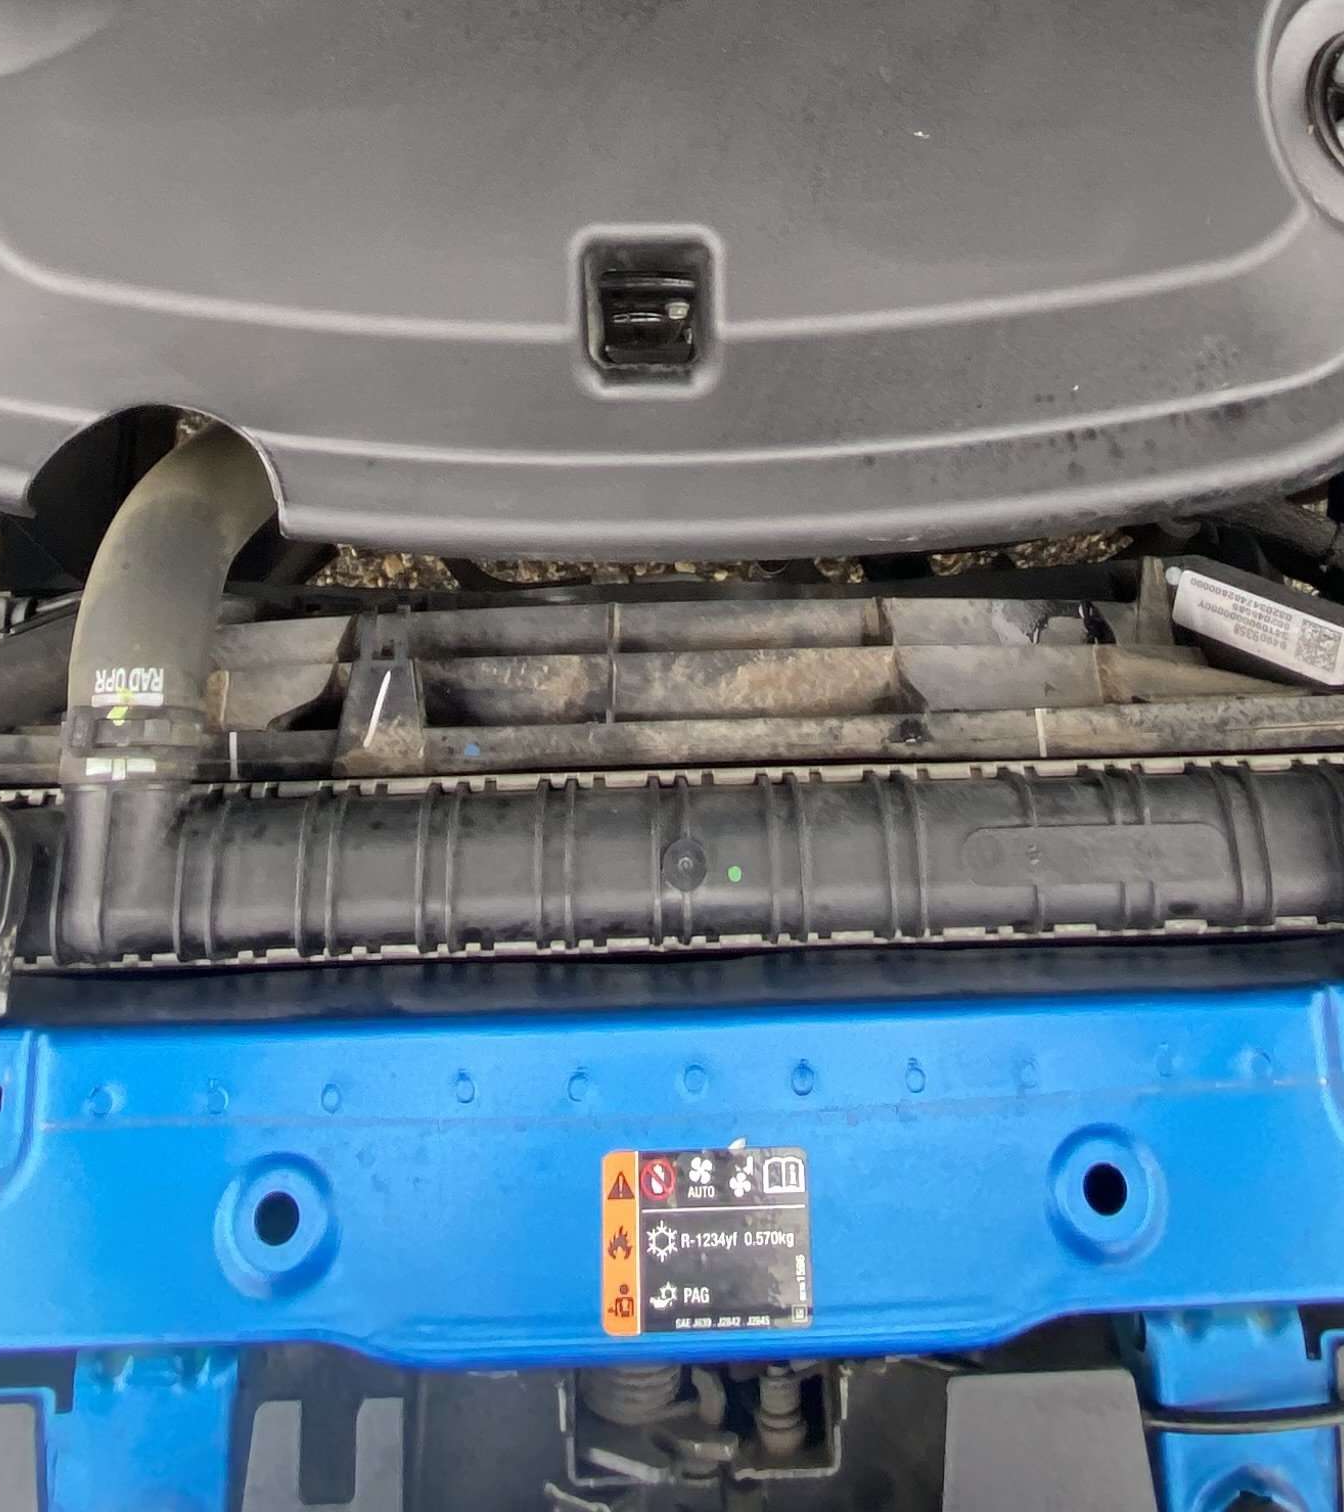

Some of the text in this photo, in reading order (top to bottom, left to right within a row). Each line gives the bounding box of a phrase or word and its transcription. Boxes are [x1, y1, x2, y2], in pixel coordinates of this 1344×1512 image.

[93, 667, 165, 693] RAD UPR
[687, 1186, 716, 1199] AUTO
[680, 1231, 795, 1250] R-1234yf 0.570kg
[683, 1288, 710, 1304] PAG
